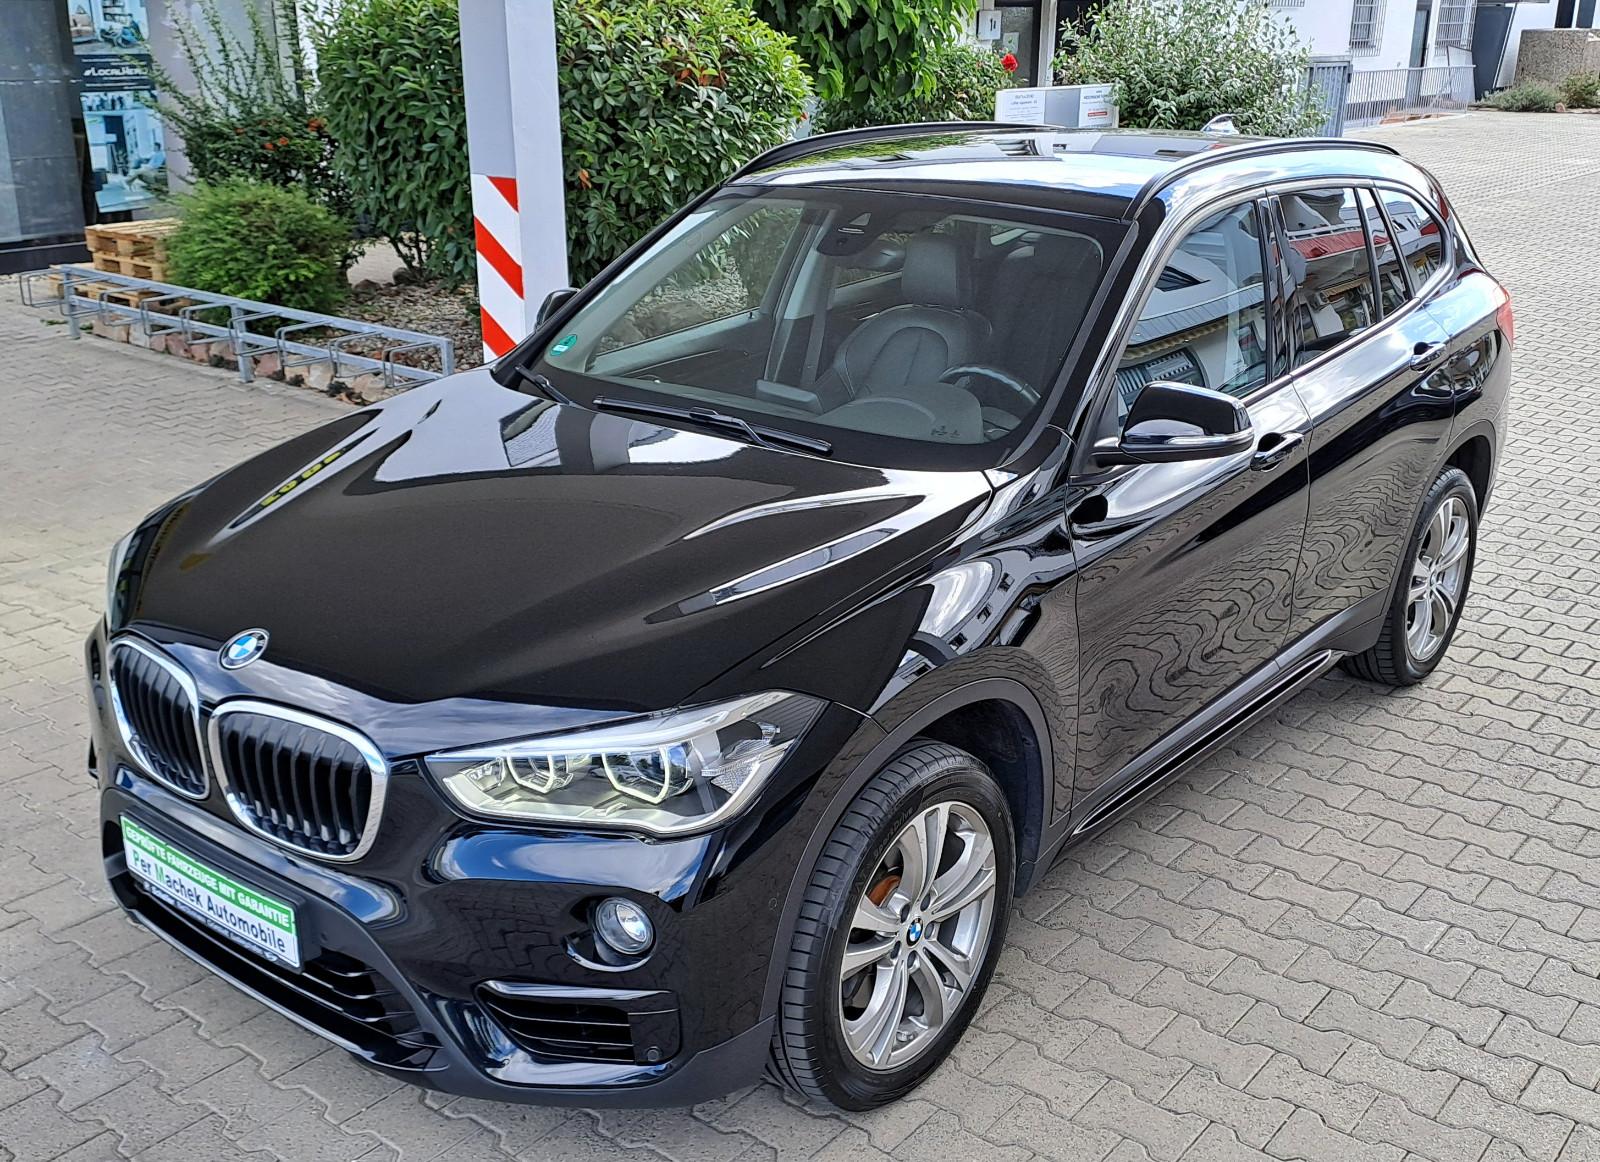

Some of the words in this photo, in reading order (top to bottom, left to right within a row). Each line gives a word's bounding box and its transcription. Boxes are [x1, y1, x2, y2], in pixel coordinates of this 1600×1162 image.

[132, 848, 151, 876] Per
[154, 862, 203, 907] Machek
[207, 894, 287, 953] Automobile
[166, 850, 218, 892] FAHRZEUGE
[217, 880, 237, 901] MIT
[237, 891, 290, 928] GARANTIE
